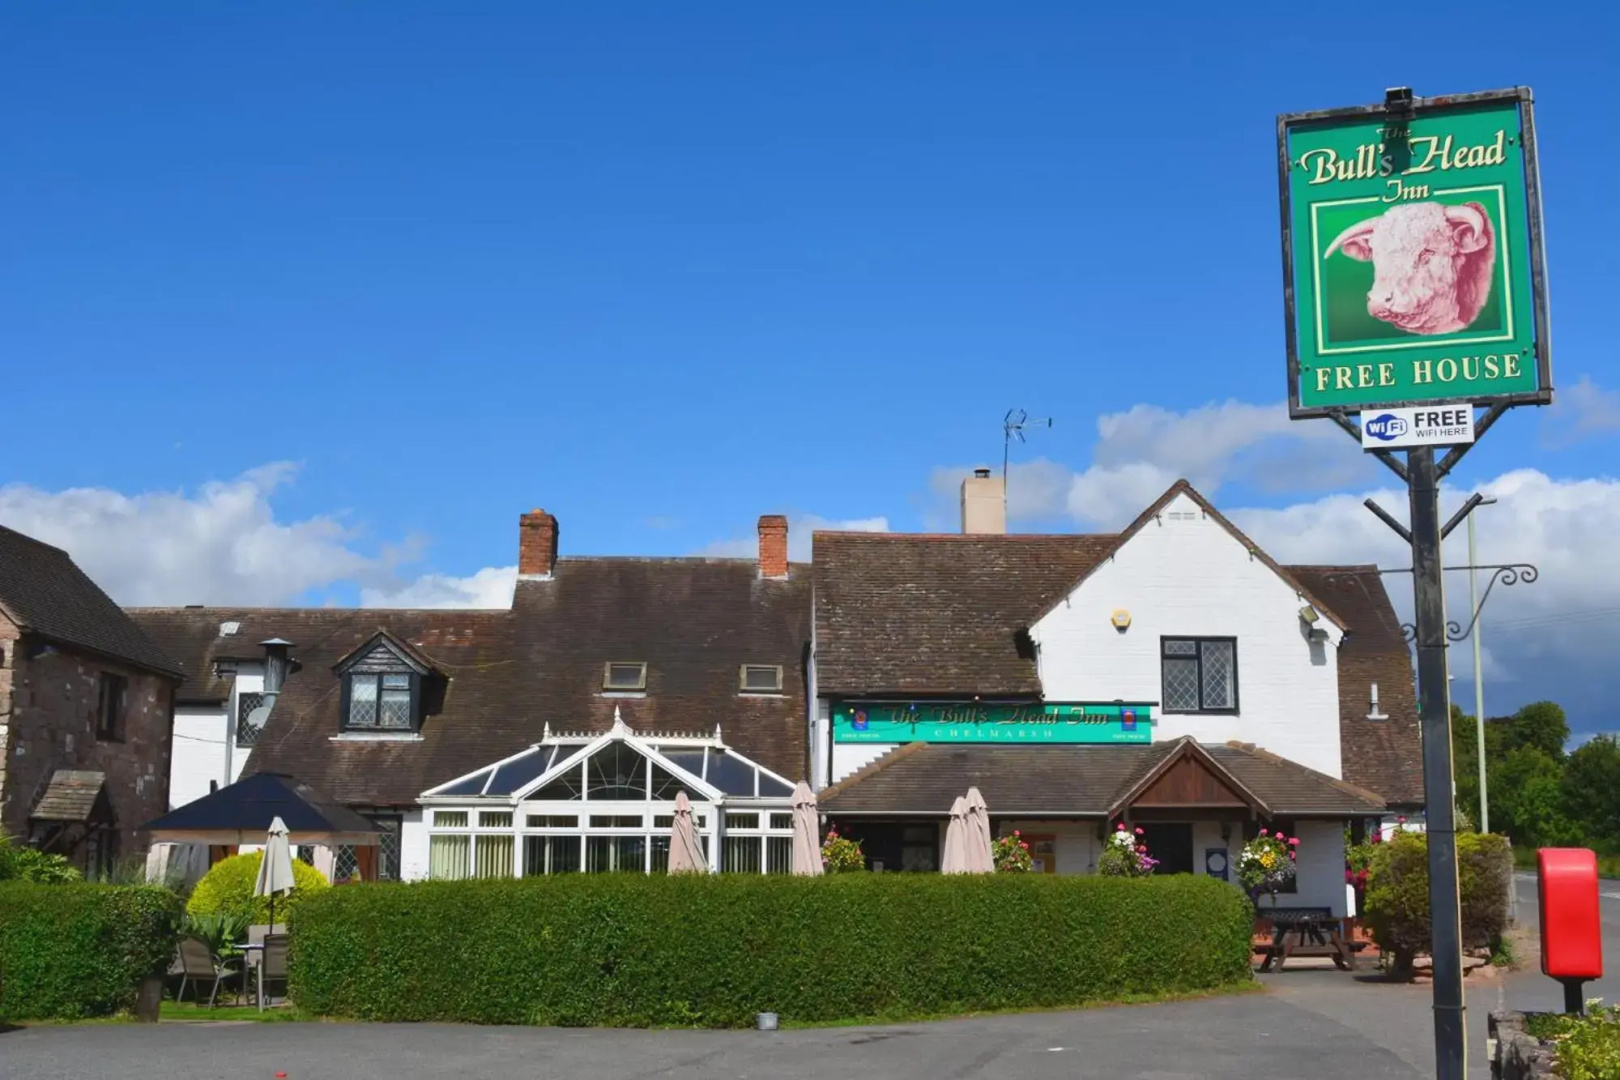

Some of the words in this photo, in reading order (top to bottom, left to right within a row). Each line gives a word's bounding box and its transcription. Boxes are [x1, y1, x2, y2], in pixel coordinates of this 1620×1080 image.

[1377, 127, 1413, 140] The
[1301, 142, 1394, 184] Bull's
[1401, 129, 1506, 176] Head
[1382, 179, 1430, 202] Inn
[1315, 362, 1396, 391] FREE
[1412, 353, 1521, 384] HOUSE
[1414, 409, 1467, 428] FREE
[1416, 428, 1437, 438] WIFI
[1440, 426, 1467, 436] HERE
[882, 706, 921, 724] The
[932, 706, 988, 725] Bull's
[996, 706, 1060, 725] Head
[1066, 706, 1108, 725] Inn
[934, 729, 1052, 738] CHELMARSH
